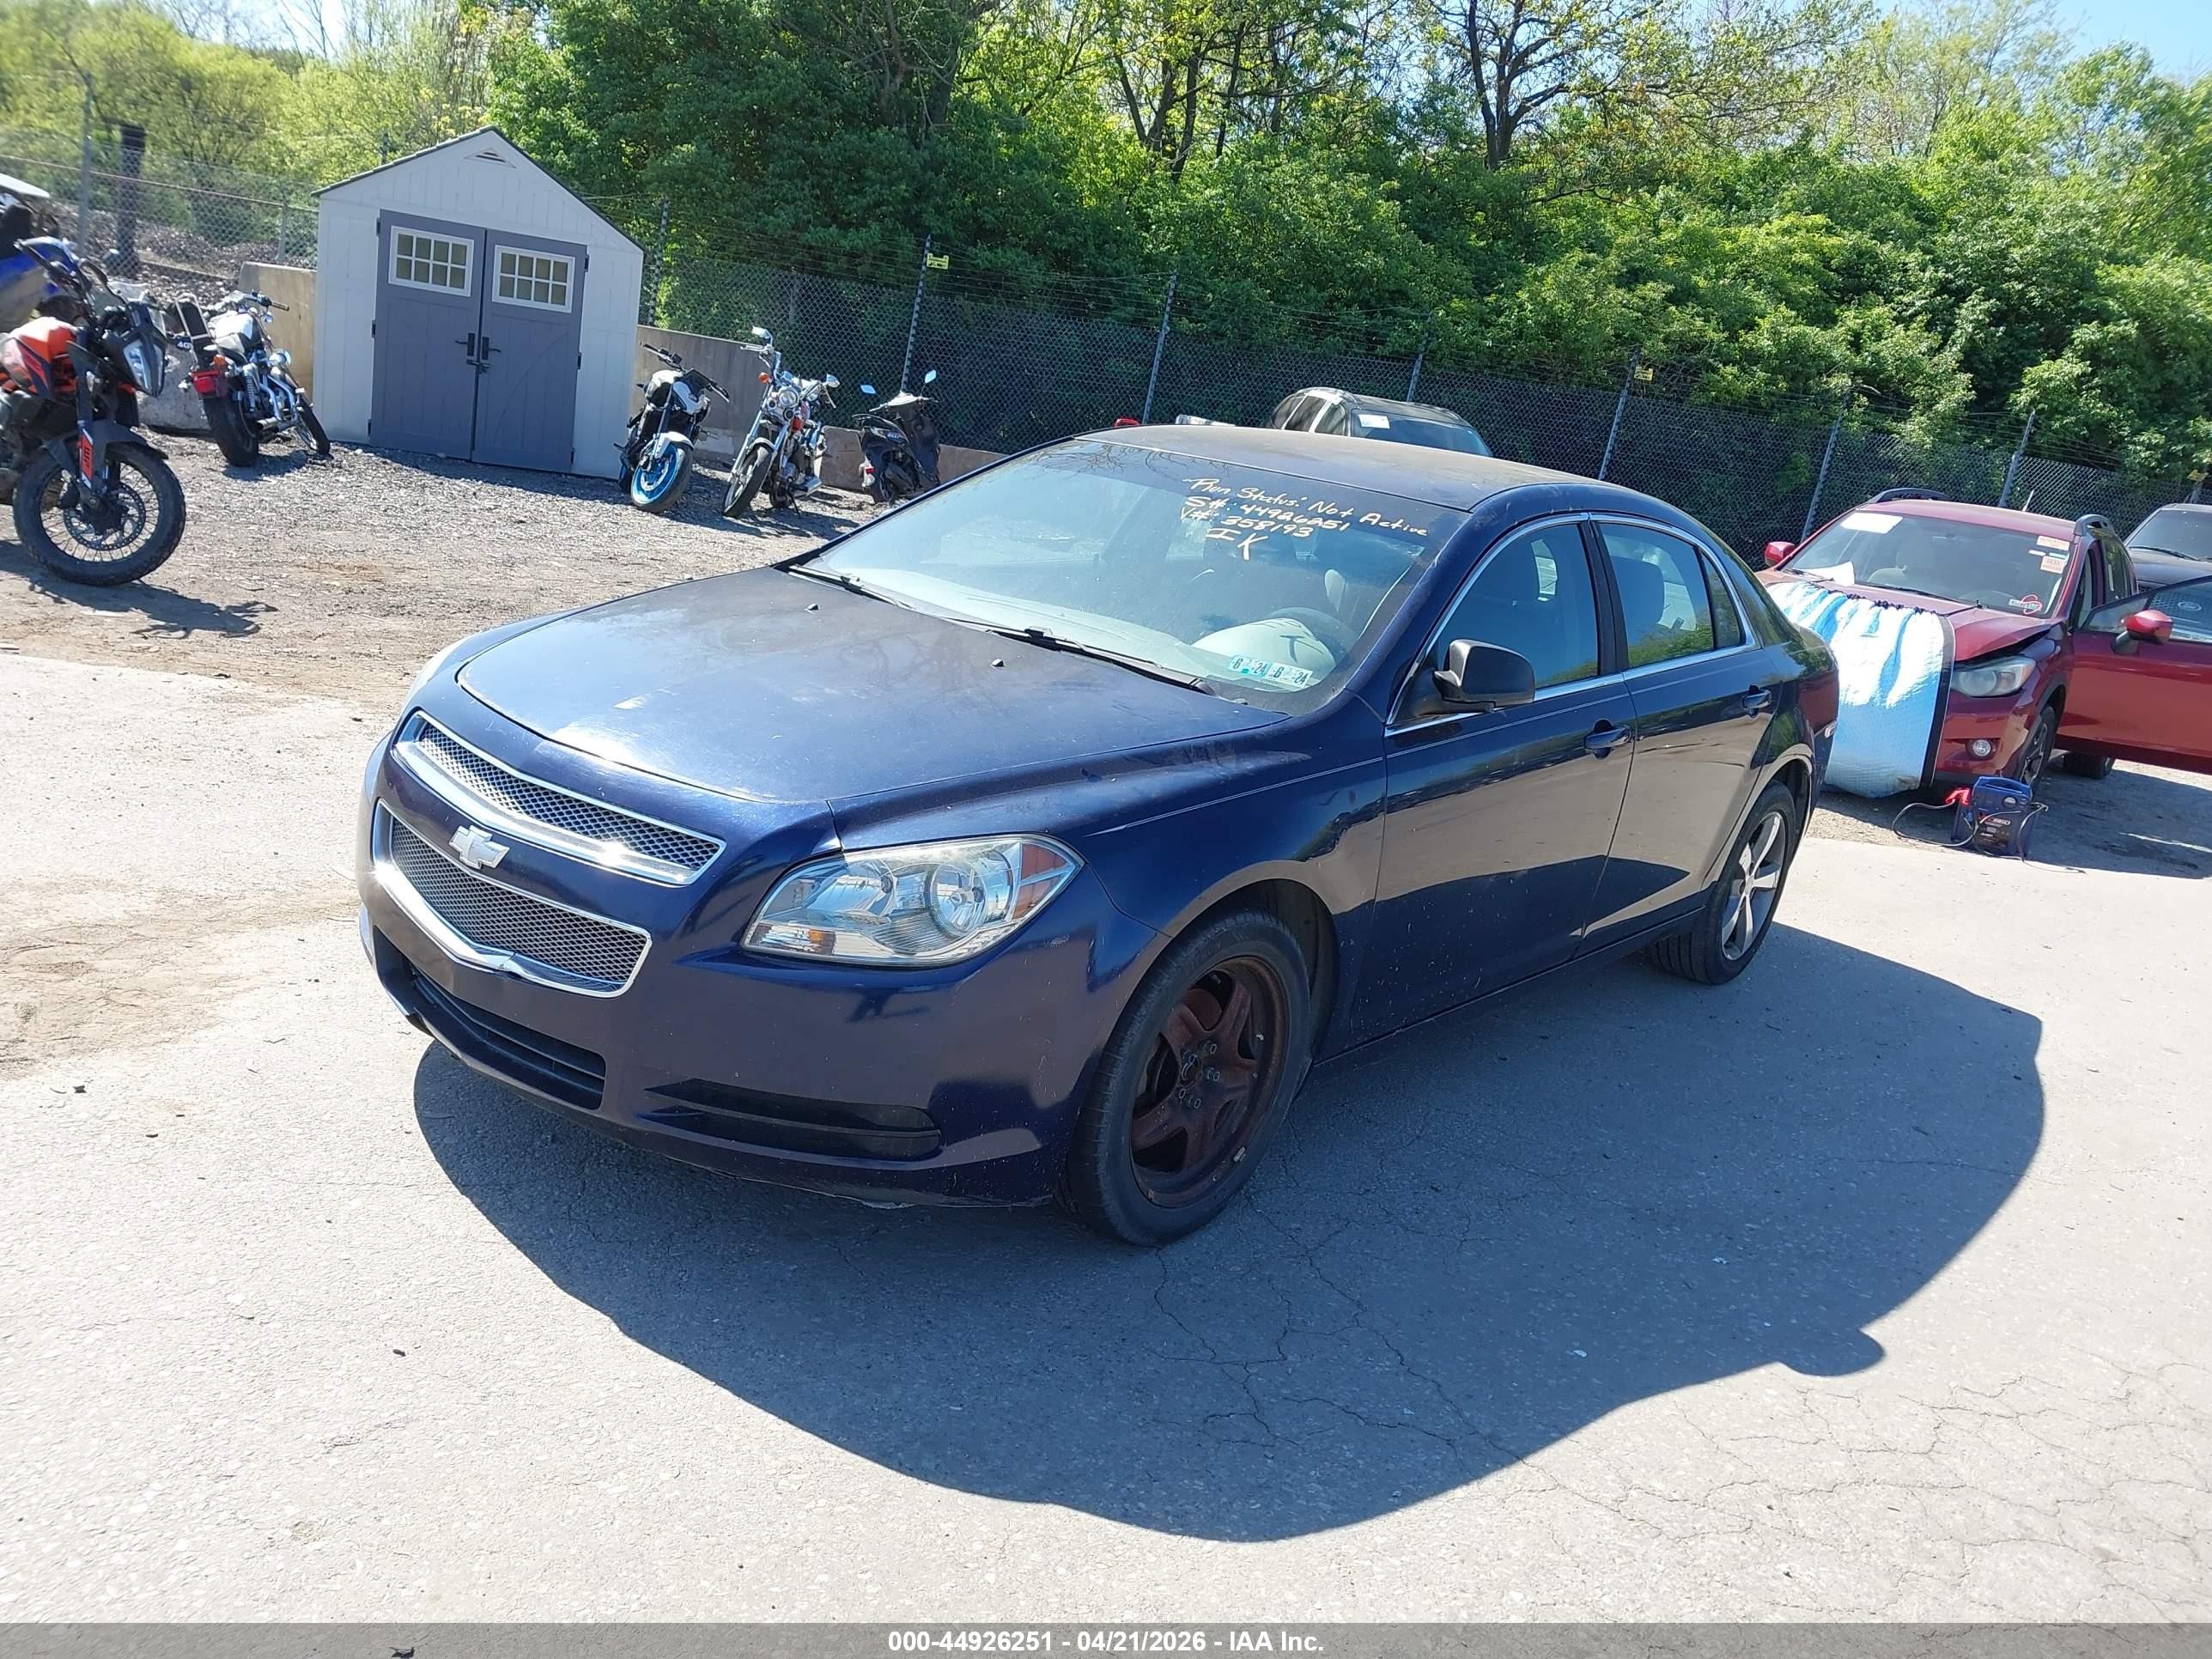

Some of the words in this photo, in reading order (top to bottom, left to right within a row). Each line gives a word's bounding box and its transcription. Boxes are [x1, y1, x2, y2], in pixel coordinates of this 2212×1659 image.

[1182, 478, 1231, 495] Run
[1308, 501, 1355, 518] Not
[1359, 514, 1429, 537] Active
[1240, 504, 1351, 531] 44926251
[1220, 515, 1314, 538] 358193
[1254, 662, 1267, 674] 24
[1294, 672, 1309, 684] 24
